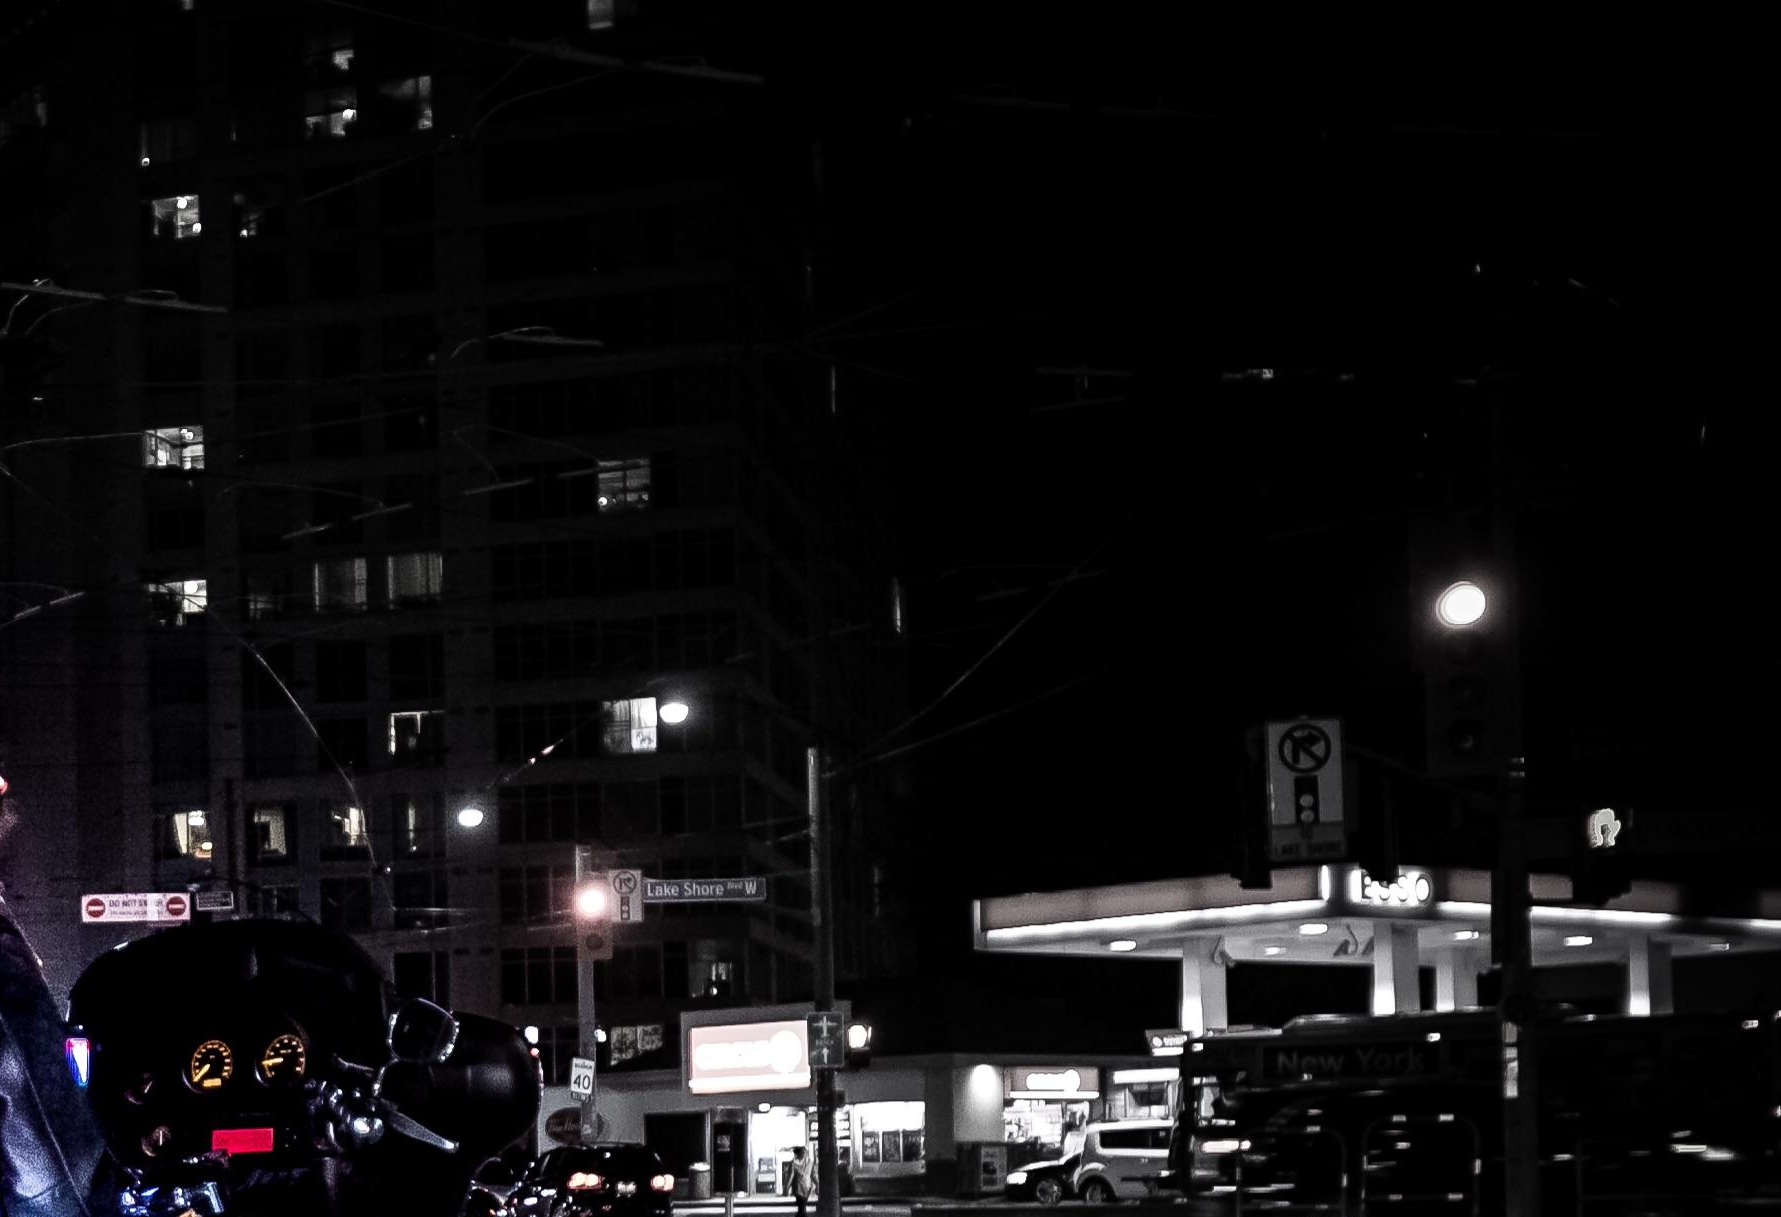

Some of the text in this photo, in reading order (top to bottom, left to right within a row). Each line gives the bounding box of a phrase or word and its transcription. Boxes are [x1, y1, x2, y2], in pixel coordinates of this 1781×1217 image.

[646, 882, 680, 897] Lake
[683, 881, 724, 897] Shore
[745, 881, 757, 895] W
[1276, 1050, 1344, 1073] New
[1355, 1046, 1426, 1073] York
[573, 1073, 591, 1090] 40
